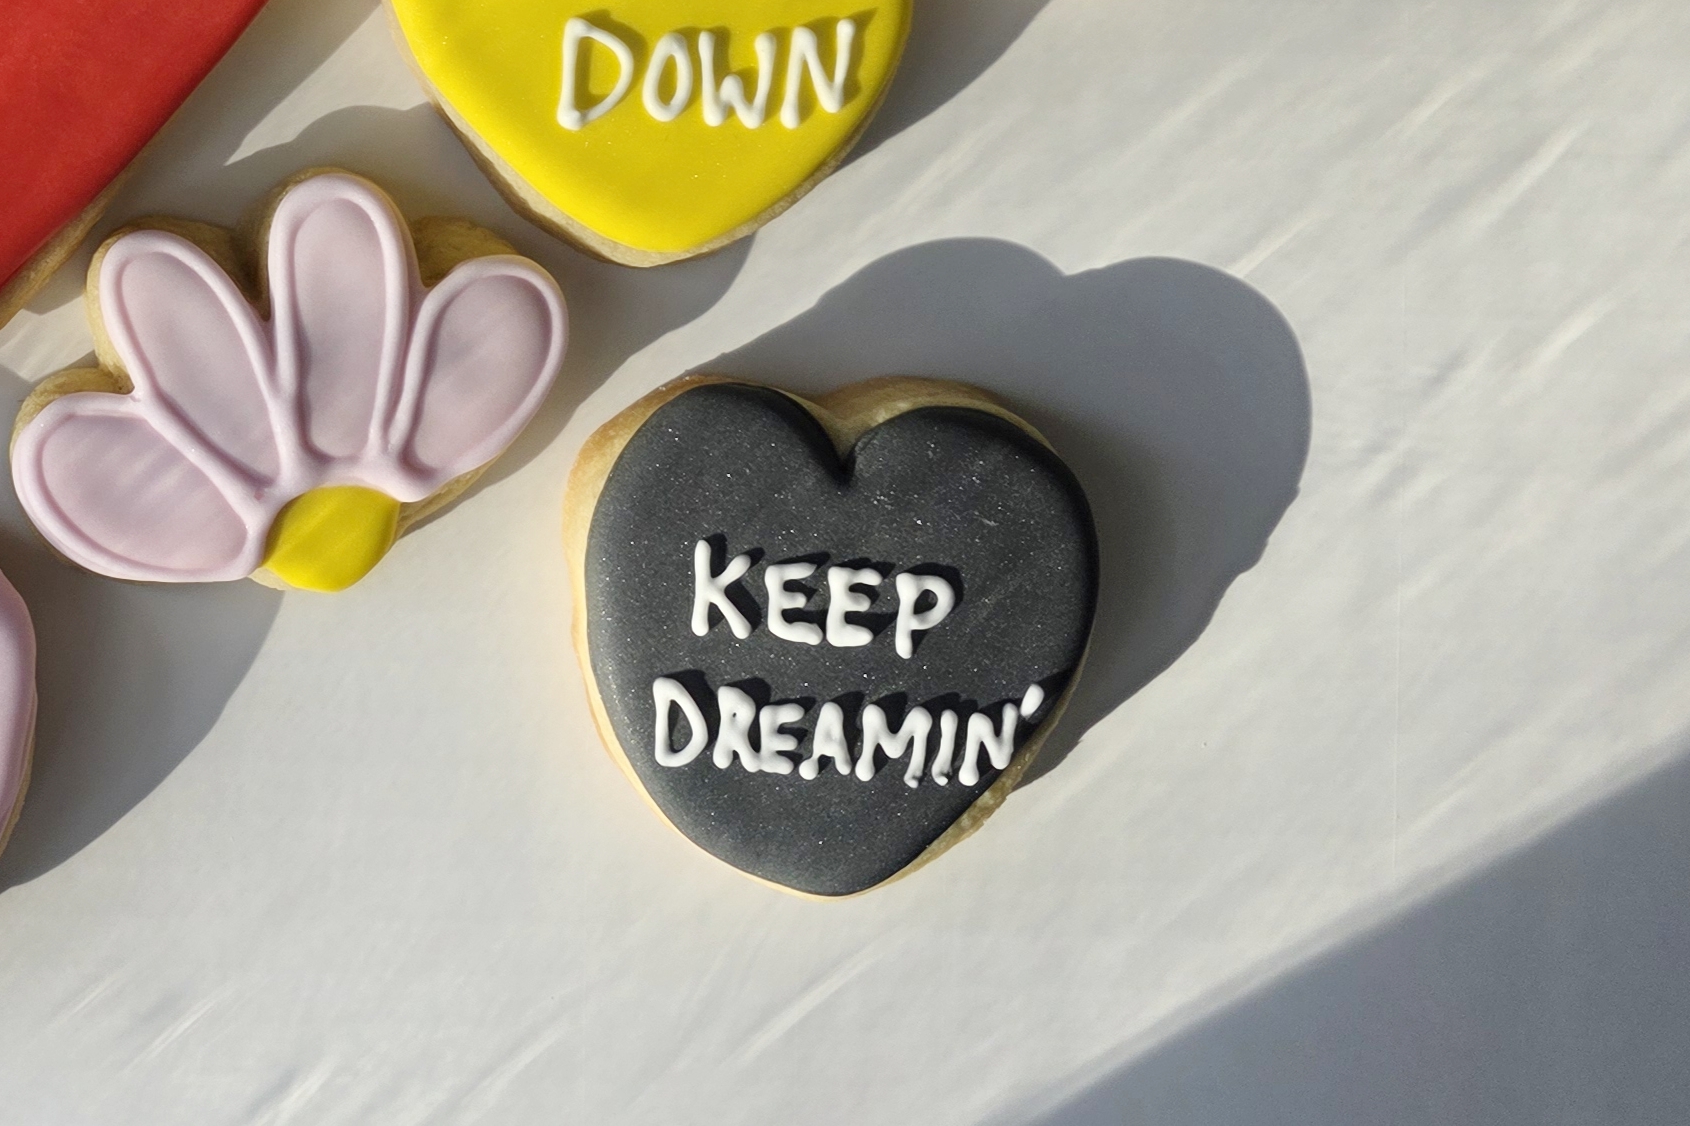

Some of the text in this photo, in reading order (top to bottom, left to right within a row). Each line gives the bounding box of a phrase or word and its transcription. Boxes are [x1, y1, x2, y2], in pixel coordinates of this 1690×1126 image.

[556, 16, 856, 131] DOWN
[690, 539, 955, 659] KEEP
[652, 676, 1044, 788] DREAMIN'
